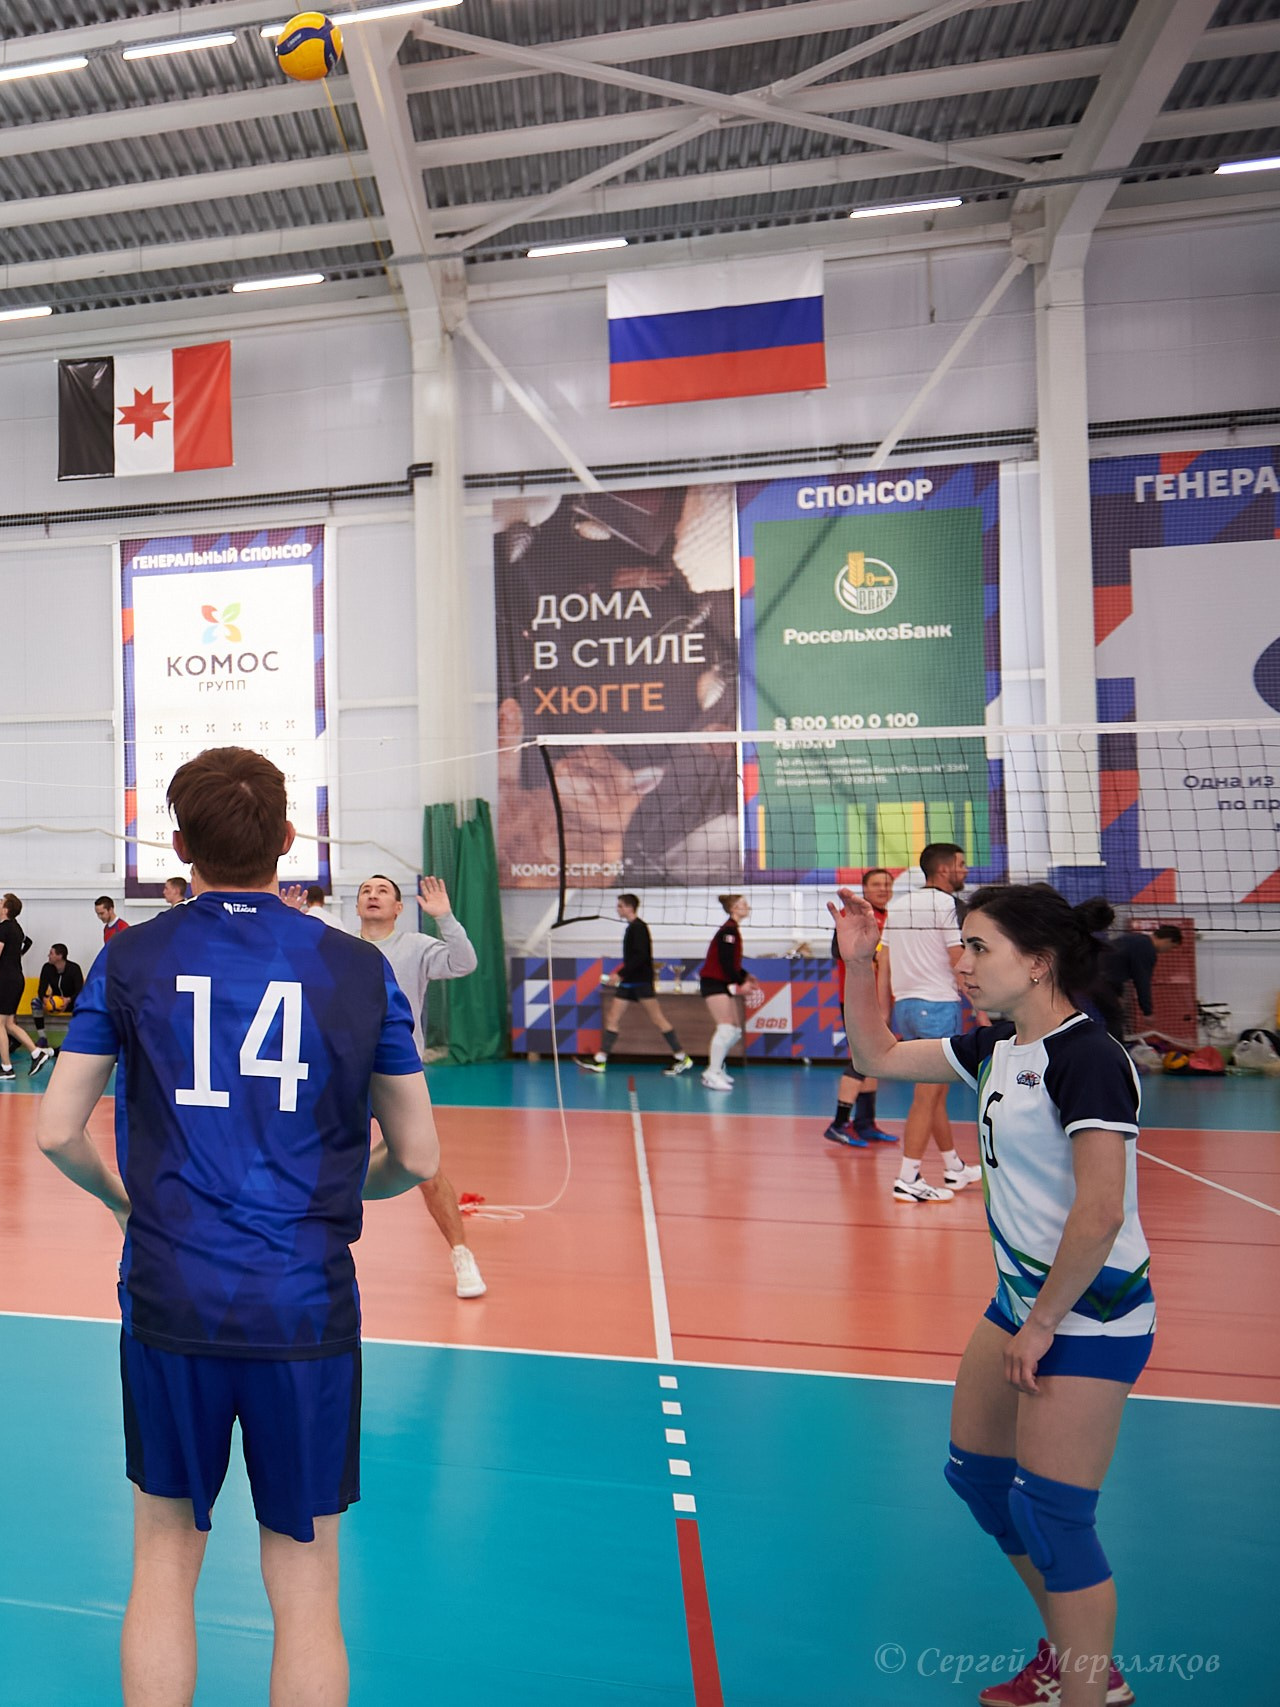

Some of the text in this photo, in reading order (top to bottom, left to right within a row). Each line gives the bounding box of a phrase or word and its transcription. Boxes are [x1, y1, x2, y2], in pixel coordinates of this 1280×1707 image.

[797, 479, 933, 509] СПОНСОР
[1135, 466, 1280, 503] ГЕНЕРА
[132, 543, 312, 570] ГЕНЕРАЛЬНЫЙ СПОНСОР
[532, 590, 652, 631] ДОМА
[783, 623, 952, 645] РоссельхозБанк
[167, 651, 279, 676] КОМОС
[534, 633, 706, 670] В СТИЛЕ
[199, 680, 246, 692] ГРУПП
[534, 682, 665, 715] ХЮГГЕ
[774, 713, 919, 731] 8 800 100 0 100
[1184, 775, 1274, 789] Одна из
[1218, 800, 1245, 810] по
[511, 861, 624, 876] КОМОСТРОЙ
[755, 1017, 788, 1029] ВФВ
[175, 975, 309, 1112] 14
